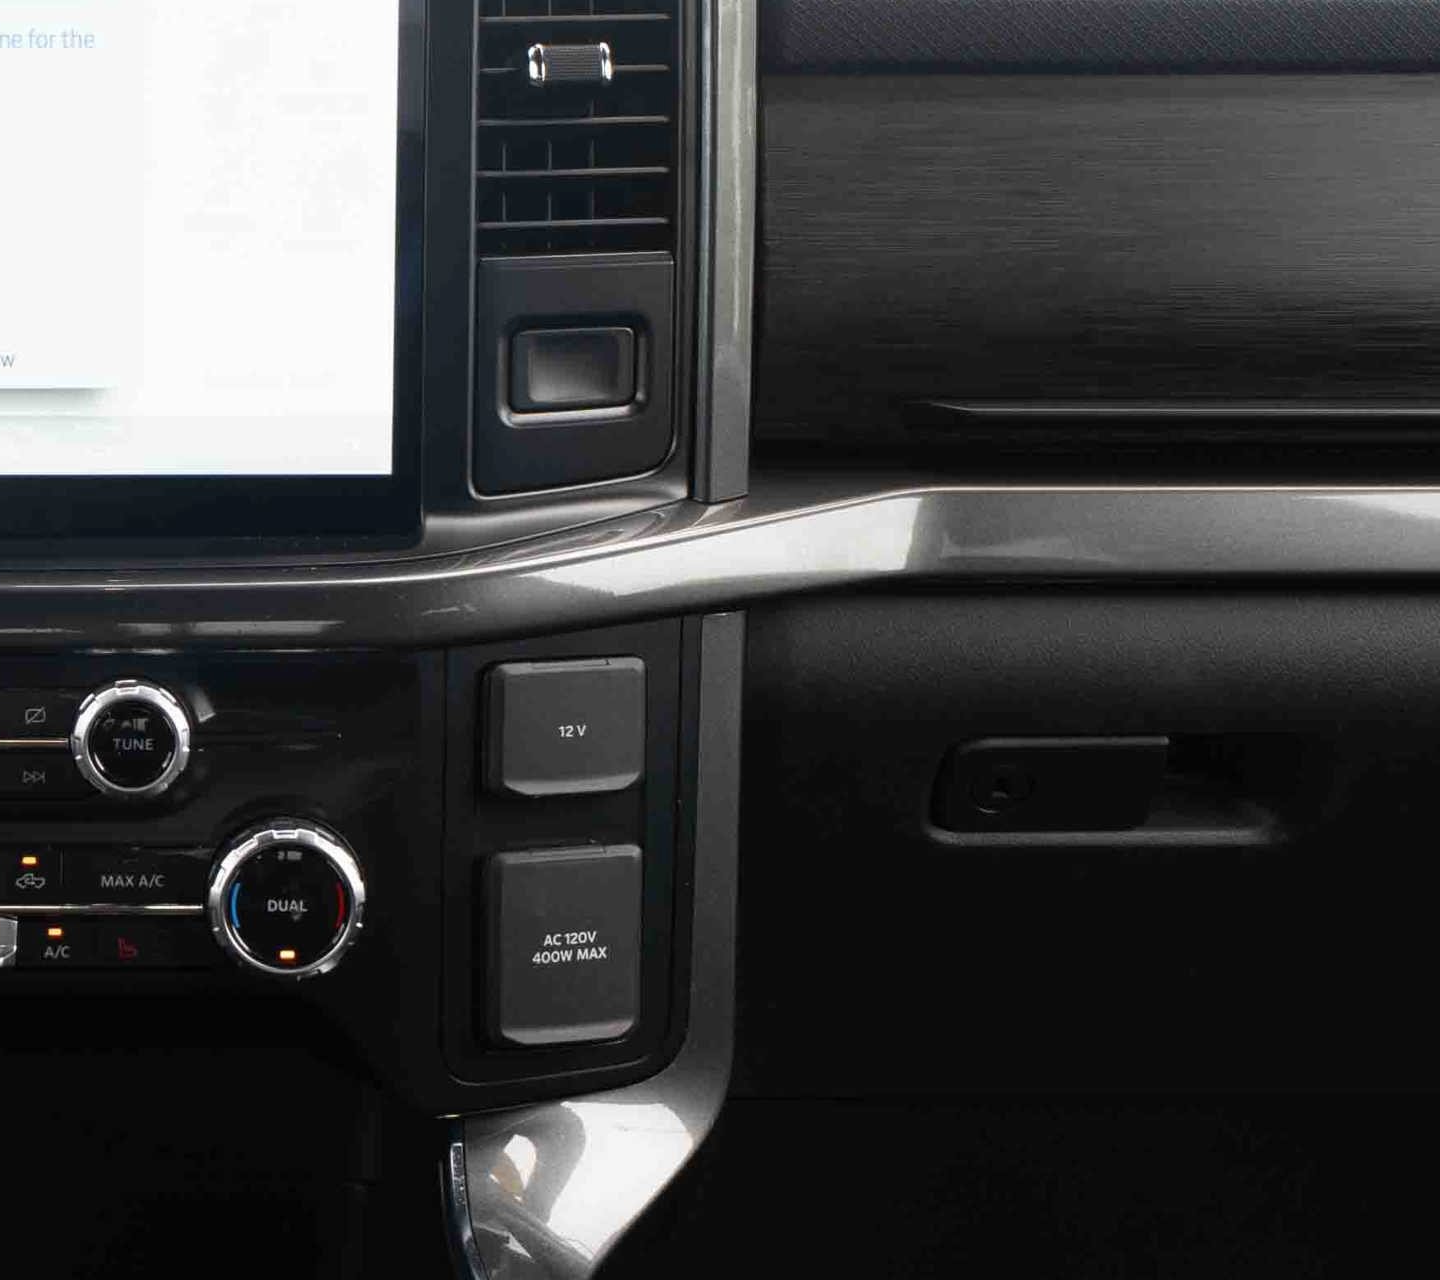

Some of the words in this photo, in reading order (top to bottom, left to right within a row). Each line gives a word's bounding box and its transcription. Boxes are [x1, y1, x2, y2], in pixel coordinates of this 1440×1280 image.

[27, 27, 57, 49] for
[60, 28, 95, 49] the
[558, 725, 574, 738] 12
[576, 724, 587, 737] V
[113, 738, 154, 752] TUNE
[100, 875, 132, 888] MAX
[137, 874, 165, 889] A/C
[267, 899, 308, 913] DUAL
[543, 933, 562, 947] AC
[564, 930, 597, 945] 120V
[44, 944, 70, 959] A/C
[531, 949, 573, 964] 400W
[576, 946, 607, 961] MAX
